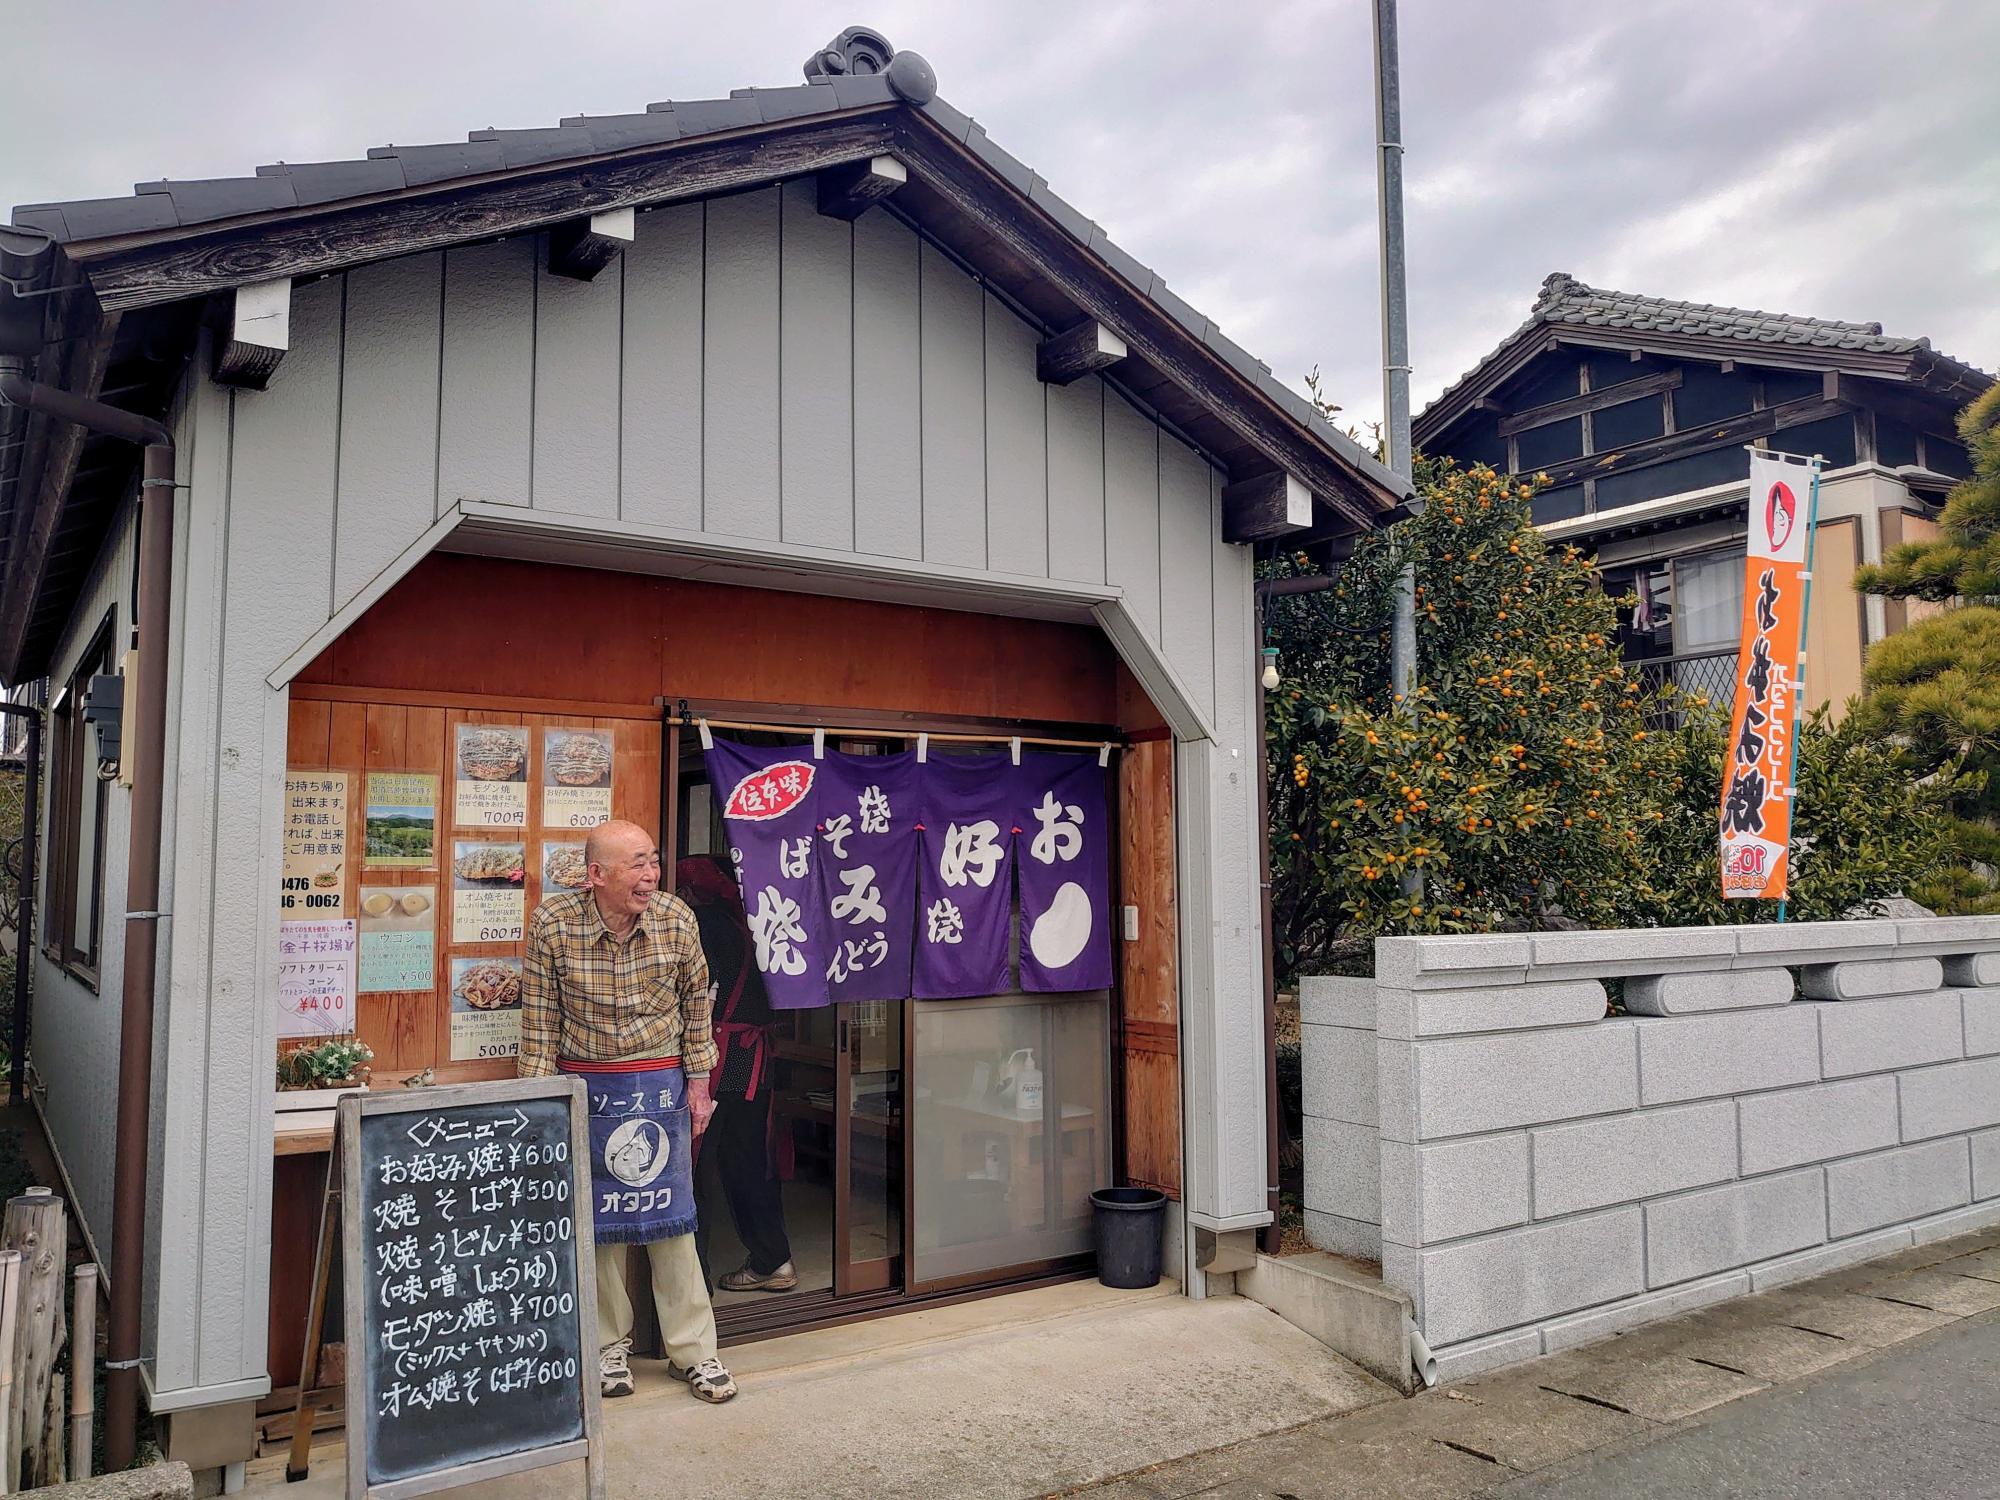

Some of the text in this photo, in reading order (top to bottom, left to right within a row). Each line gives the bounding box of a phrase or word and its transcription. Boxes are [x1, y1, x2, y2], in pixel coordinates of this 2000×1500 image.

[285, 780, 344, 792] お持ち帰り
[473, 784, 511, 794] モダン焼
[546, 789, 609, 798] お好み焼ミックス
[292, 796, 344, 810] 出来ます。
[484, 811, 524, 823] 700円
[570, 814, 609, 826] 600円
[465, 892, 513, 901] オム焼そば
[380, 933, 416, 943] ウコン
[480, 927, 522, 941] 600円
[280, 963, 344, 974] ソフトクリーム
[308, 977, 335, 986] コーン
[300, 995, 343, 1012] ¥400
[461, 1011, 513, 1021] 味噌焼うどん
[478, 1042, 519, 1057] 500円
[600, 1187, 673, 1213] オタフク
[382, 1297, 497, 1350] モダン焼
